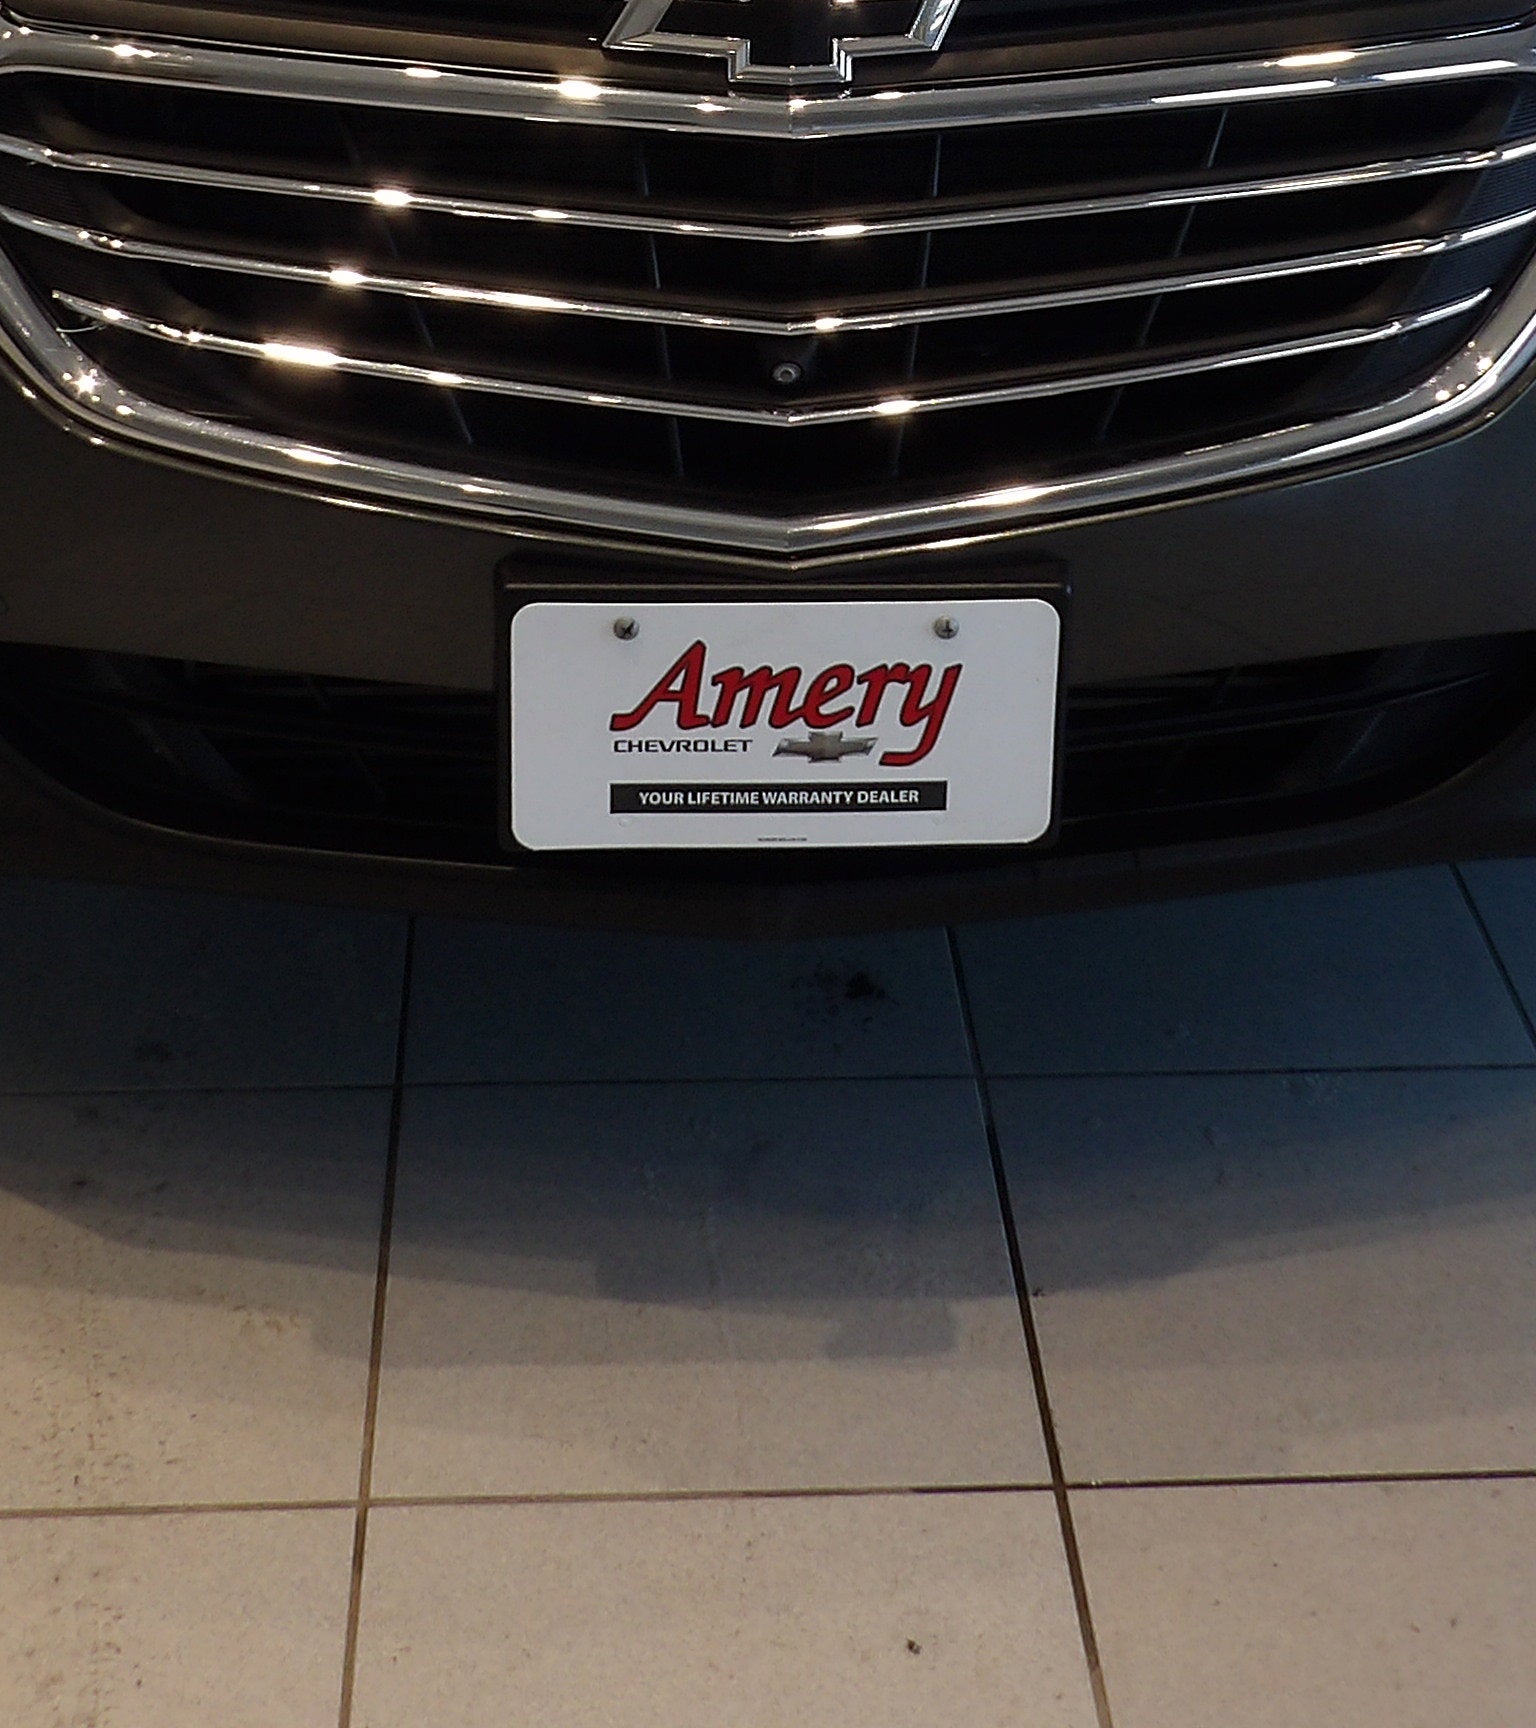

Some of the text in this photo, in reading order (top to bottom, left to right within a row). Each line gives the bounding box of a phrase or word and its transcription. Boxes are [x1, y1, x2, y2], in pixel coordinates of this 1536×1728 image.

[609, 639, 963, 767] Amery
[613, 739, 753, 753] CHEVROLET
[639, 790, 920, 806] YOUR LIFETIME WARRANTY DEALER
